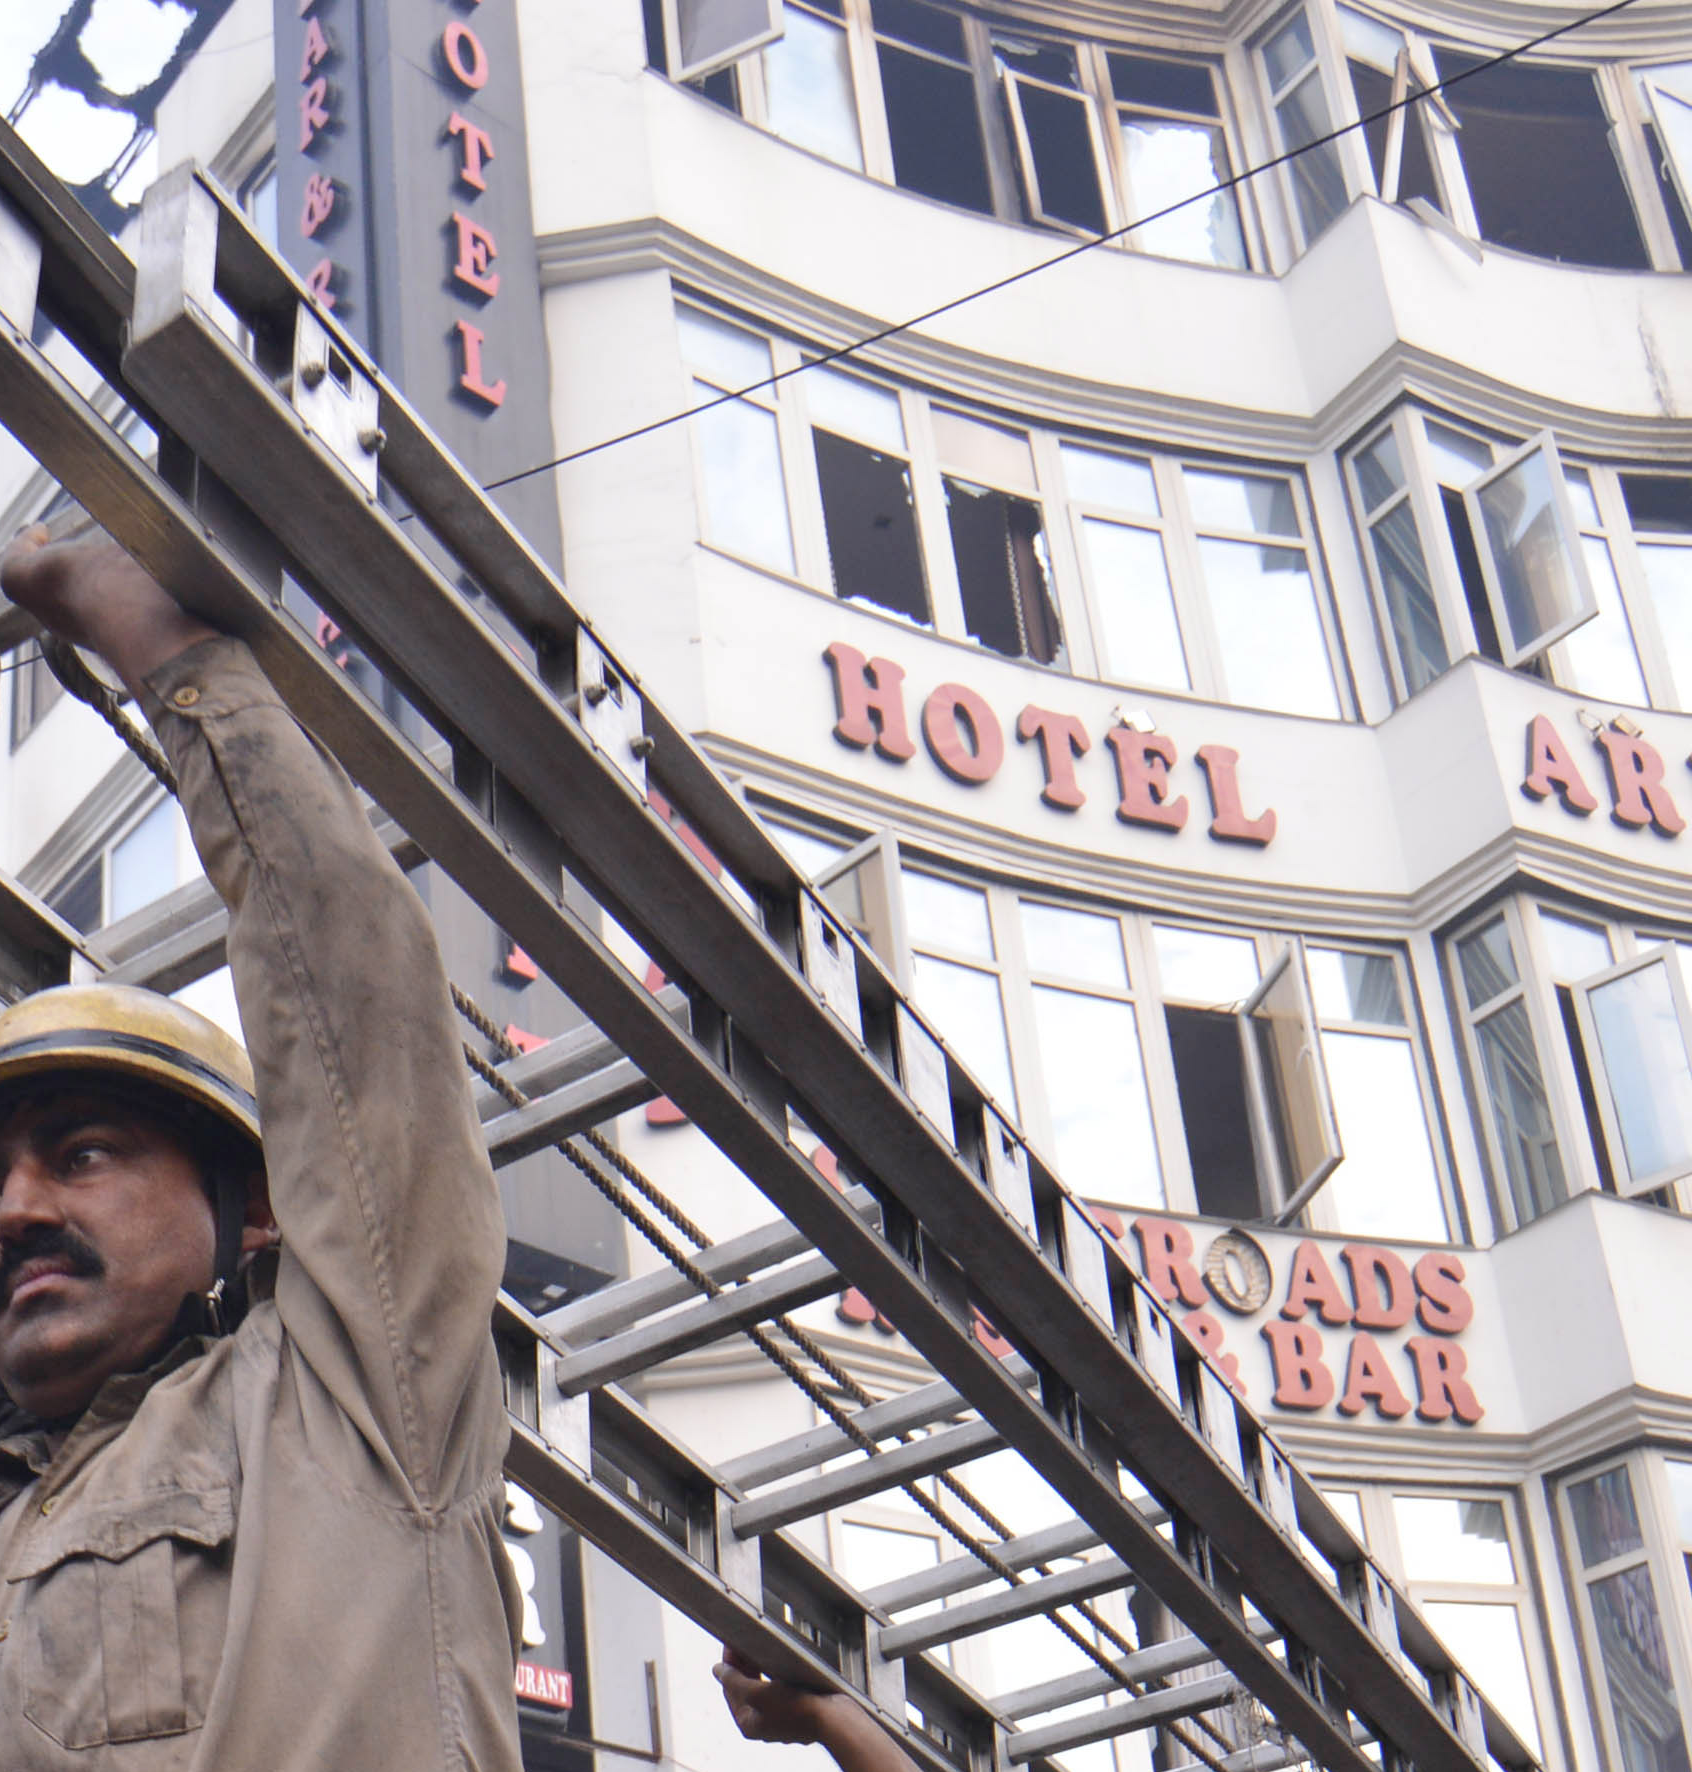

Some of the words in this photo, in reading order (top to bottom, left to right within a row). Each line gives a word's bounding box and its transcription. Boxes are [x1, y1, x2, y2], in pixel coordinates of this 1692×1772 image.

[299, 0, 329, 153] AR
[443, 0, 506, 407] OTEL
[823, 641, 1276, 847] HOTEL
[1260, 1319, 1485, 1425] BAR
[515, 1663, 569, 1703] URANT
